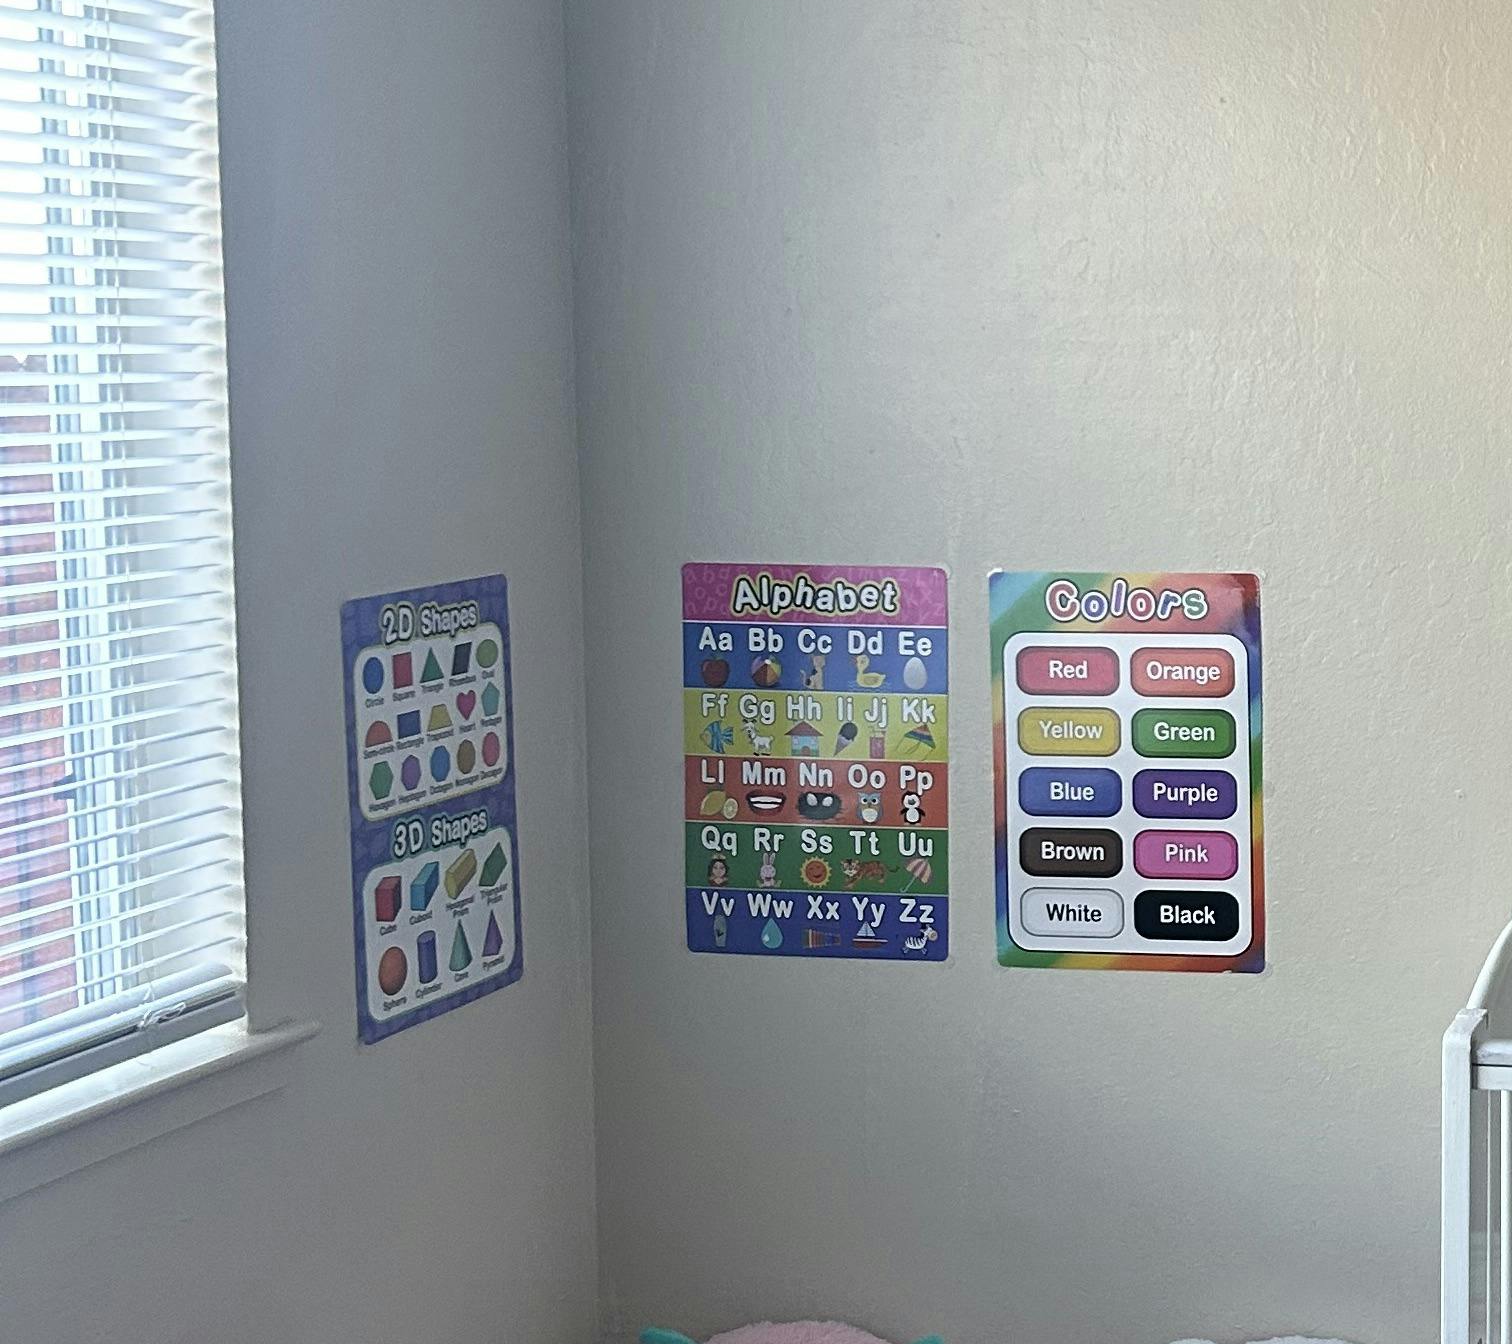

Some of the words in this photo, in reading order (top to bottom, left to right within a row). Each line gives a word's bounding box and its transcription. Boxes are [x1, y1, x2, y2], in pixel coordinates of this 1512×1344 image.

[734, 575, 897, 614] Alphabet
[1046, 580, 1209, 622] Colors
[382, 606, 413, 645] 2D
[421, 604, 477, 638] Shapes
[698, 626, 733, 651] Aa
[748, 627, 784, 653] Bb
[797, 628, 832, 654] Cc
[848, 630, 883, 657] Dd
[898, 631, 932, 658] Ee
[1049, 660, 1088, 679] Red
[1146, 661, 1221, 685] Orange
[702, 693, 728, 717] Ff
[739, 694, 775, 726] Gg
[787, 695, 821, 722] Hh
[837, 696, 852, 721] Ii
[864, 697, 887, 728] Jj
[902, 698, 935, 723] Kk
[1039, 720, 1103, 739] Yellow
[1153, 721, 1215, 741] Green
[701, 759, 724, 784] Ll
[742, 760, 786, 786] Mm
[799, 762, 833, 788] Nn
[847, 763, 886, 789] Oo
[900, 765, 933, 796] Pp
[1050, 781, 1095, 801] Blue
[1153, 782, 1218, 806] Purple
[394, 819, 424, 858] 3D
[431, 810, 488, 848] Shapes
[701, 825, 737, 855] Qq
[754, 827, 785, 852] Rr
[801, 828, 833, 854] Ss
[849, 830, 880, 856] Tt
[898, 831, 933, 857] Uu
[1041, 841, 1105, 861] Brown
[1165, 843, 1209, 863] Pink
[701, 891, 735, 917] Vv
[746, 893, 794, 919] Ww
[807, 894, 840, 921] Xx
[851, 896, 886, 931] Yy
[899, 898, 935, 924] Zz
[1045, 903, 1102, 923] White
[1160, 904, 1216, 925] Black
